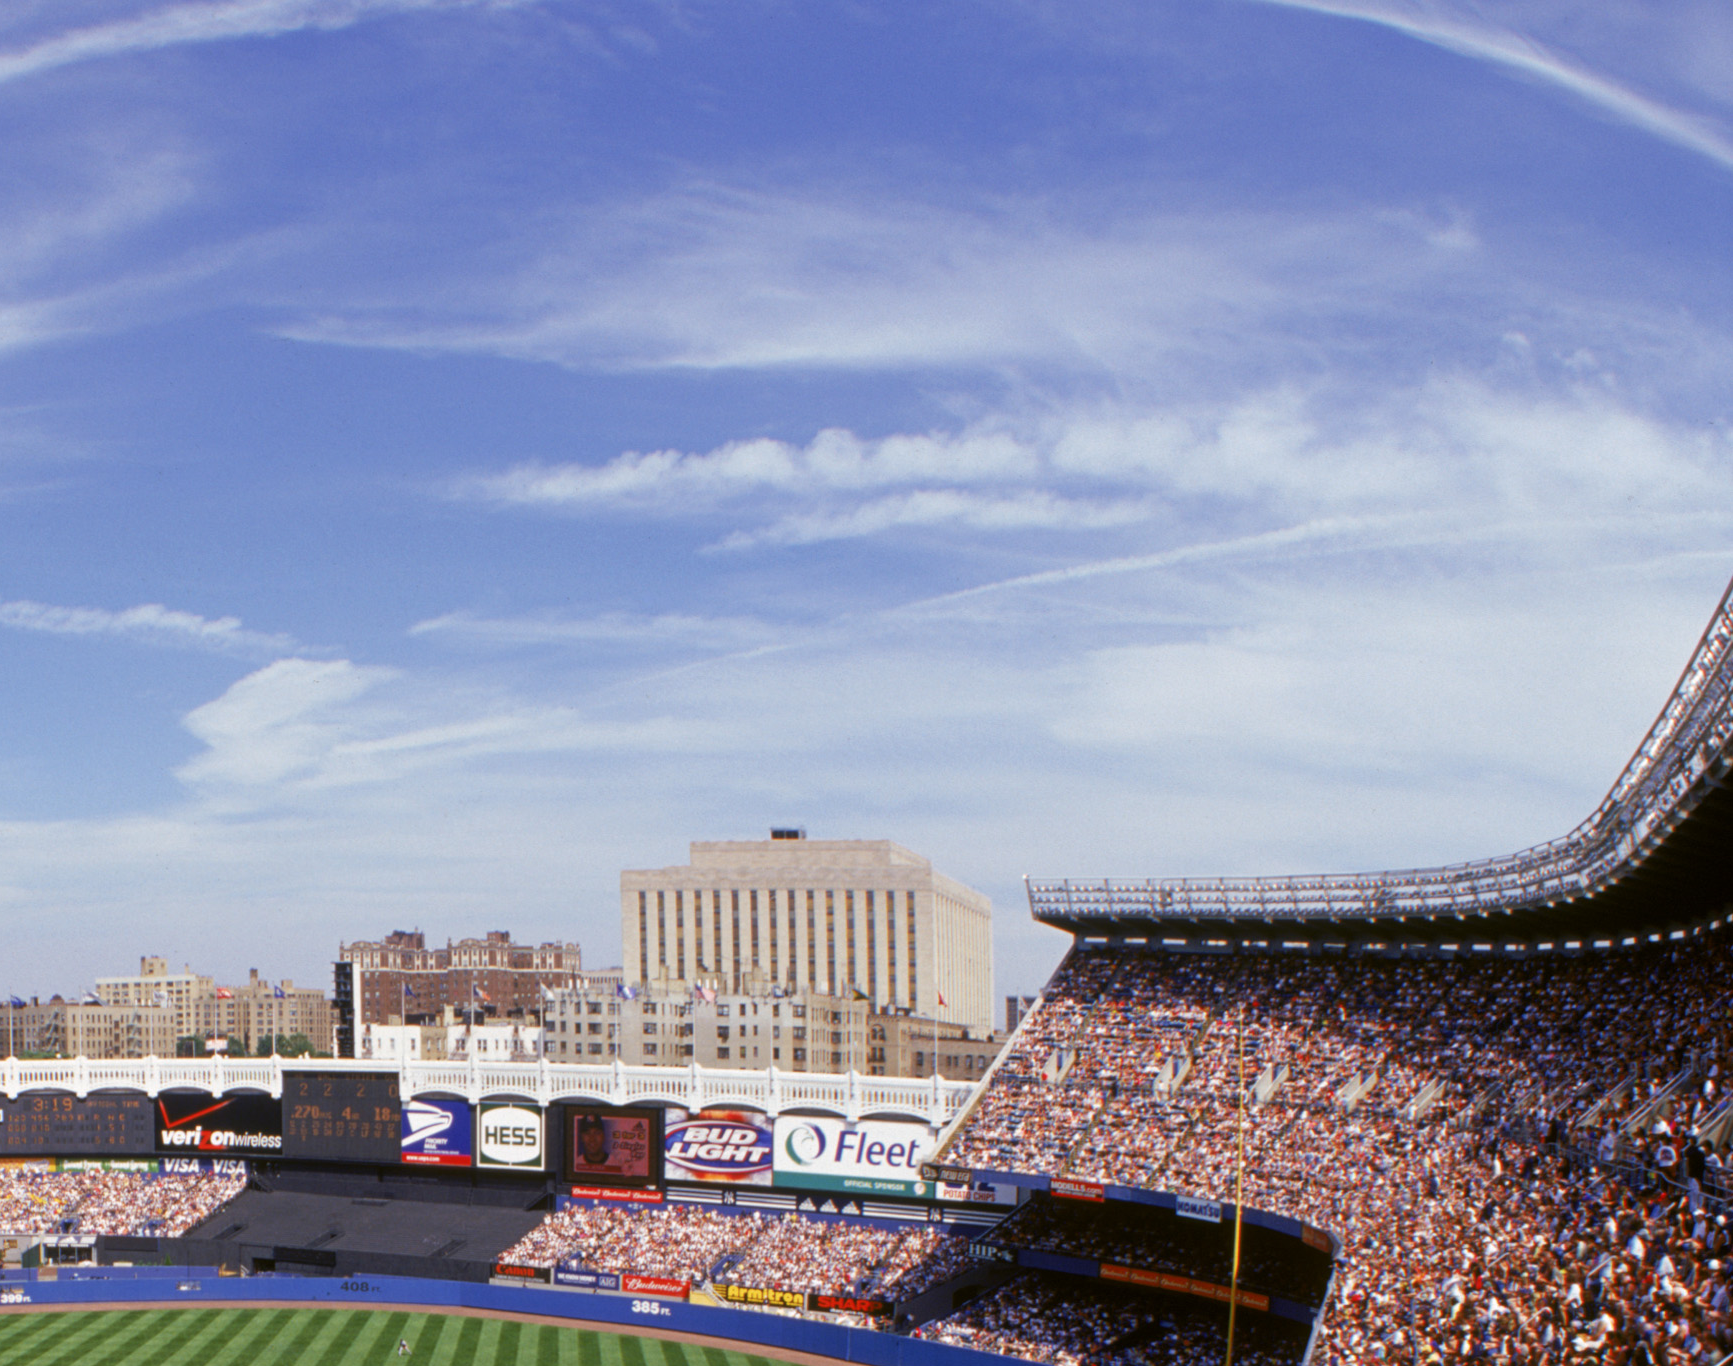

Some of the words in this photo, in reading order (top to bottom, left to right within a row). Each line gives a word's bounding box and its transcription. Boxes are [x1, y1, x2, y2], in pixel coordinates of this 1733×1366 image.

[34, 1098, 72, 1111] 3:19
[484, 1125, 537, 1147] HESS
[682, 1126, 758, 1146] BUD
[669, 1142, 771, 1163] LIGHT
[833, 1130, 921, 1169] Fleet
[164, 1158, 201, 1173] VISA
[212, 1159, 247, 1175] VISA
[844, 1178, 873, 1189] OFFICIAL
[874, 1180, 906, 1192] SPONSOR
[943, 1189, 971, 1201] POTATO
[973, 1190, 996, 1202] CHIPS
[1177, 1201, 1221, 1218] KOMATSU
[969, 1243, 997, 1257] HIP
[495, 1264, 535, 1277] Canon
[340, 1281, 370, 1293] 408
[599, 1276, 615, 1287] AIG
[625, 1278, 683, 1292] Budweiser
[0, 1293, 23, 1304] 399
[727, 1284, 804, 1304] Armitron
[631, 1300, 660, 1315] 385
[817, 1295, 883, 1312] SHARP
